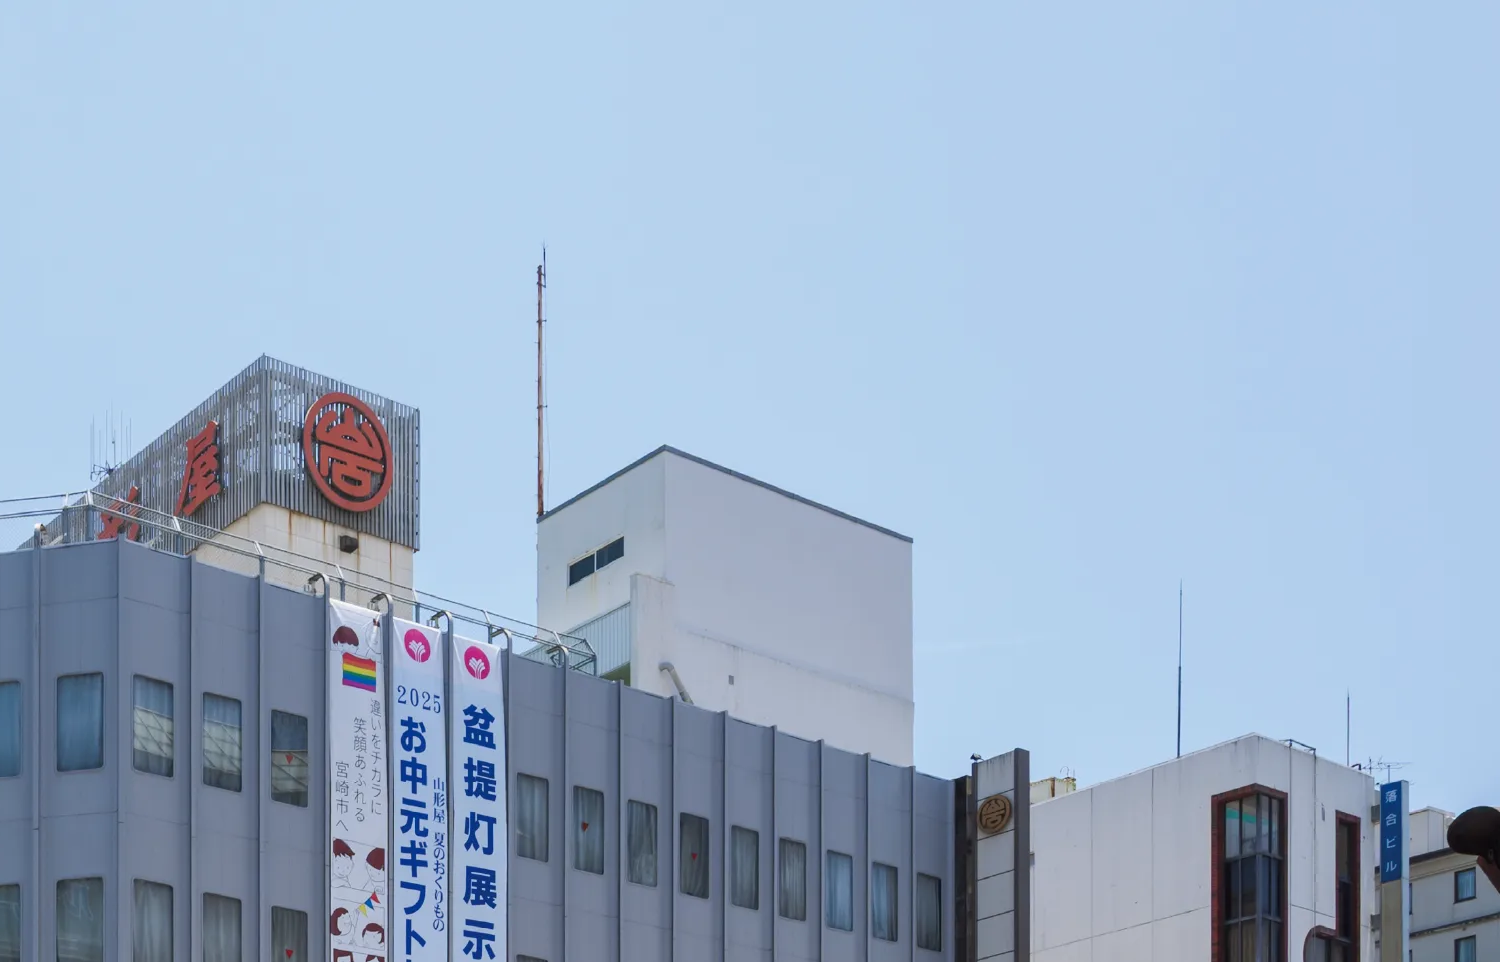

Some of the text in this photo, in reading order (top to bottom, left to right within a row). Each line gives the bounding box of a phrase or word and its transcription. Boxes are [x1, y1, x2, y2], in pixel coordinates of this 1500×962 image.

[397, 685, 441, 714] 2025
[335, 760, 350, 832] 宮崎市へ
[353, 718, 368, 822] 笑顔あふれる
[370, 699, 382, 815] 違いをチカラに
[432, 777, 446, 932] 山形屋 夏のおくりもの
[1385, 790, 1398, 872] 落合ビル
